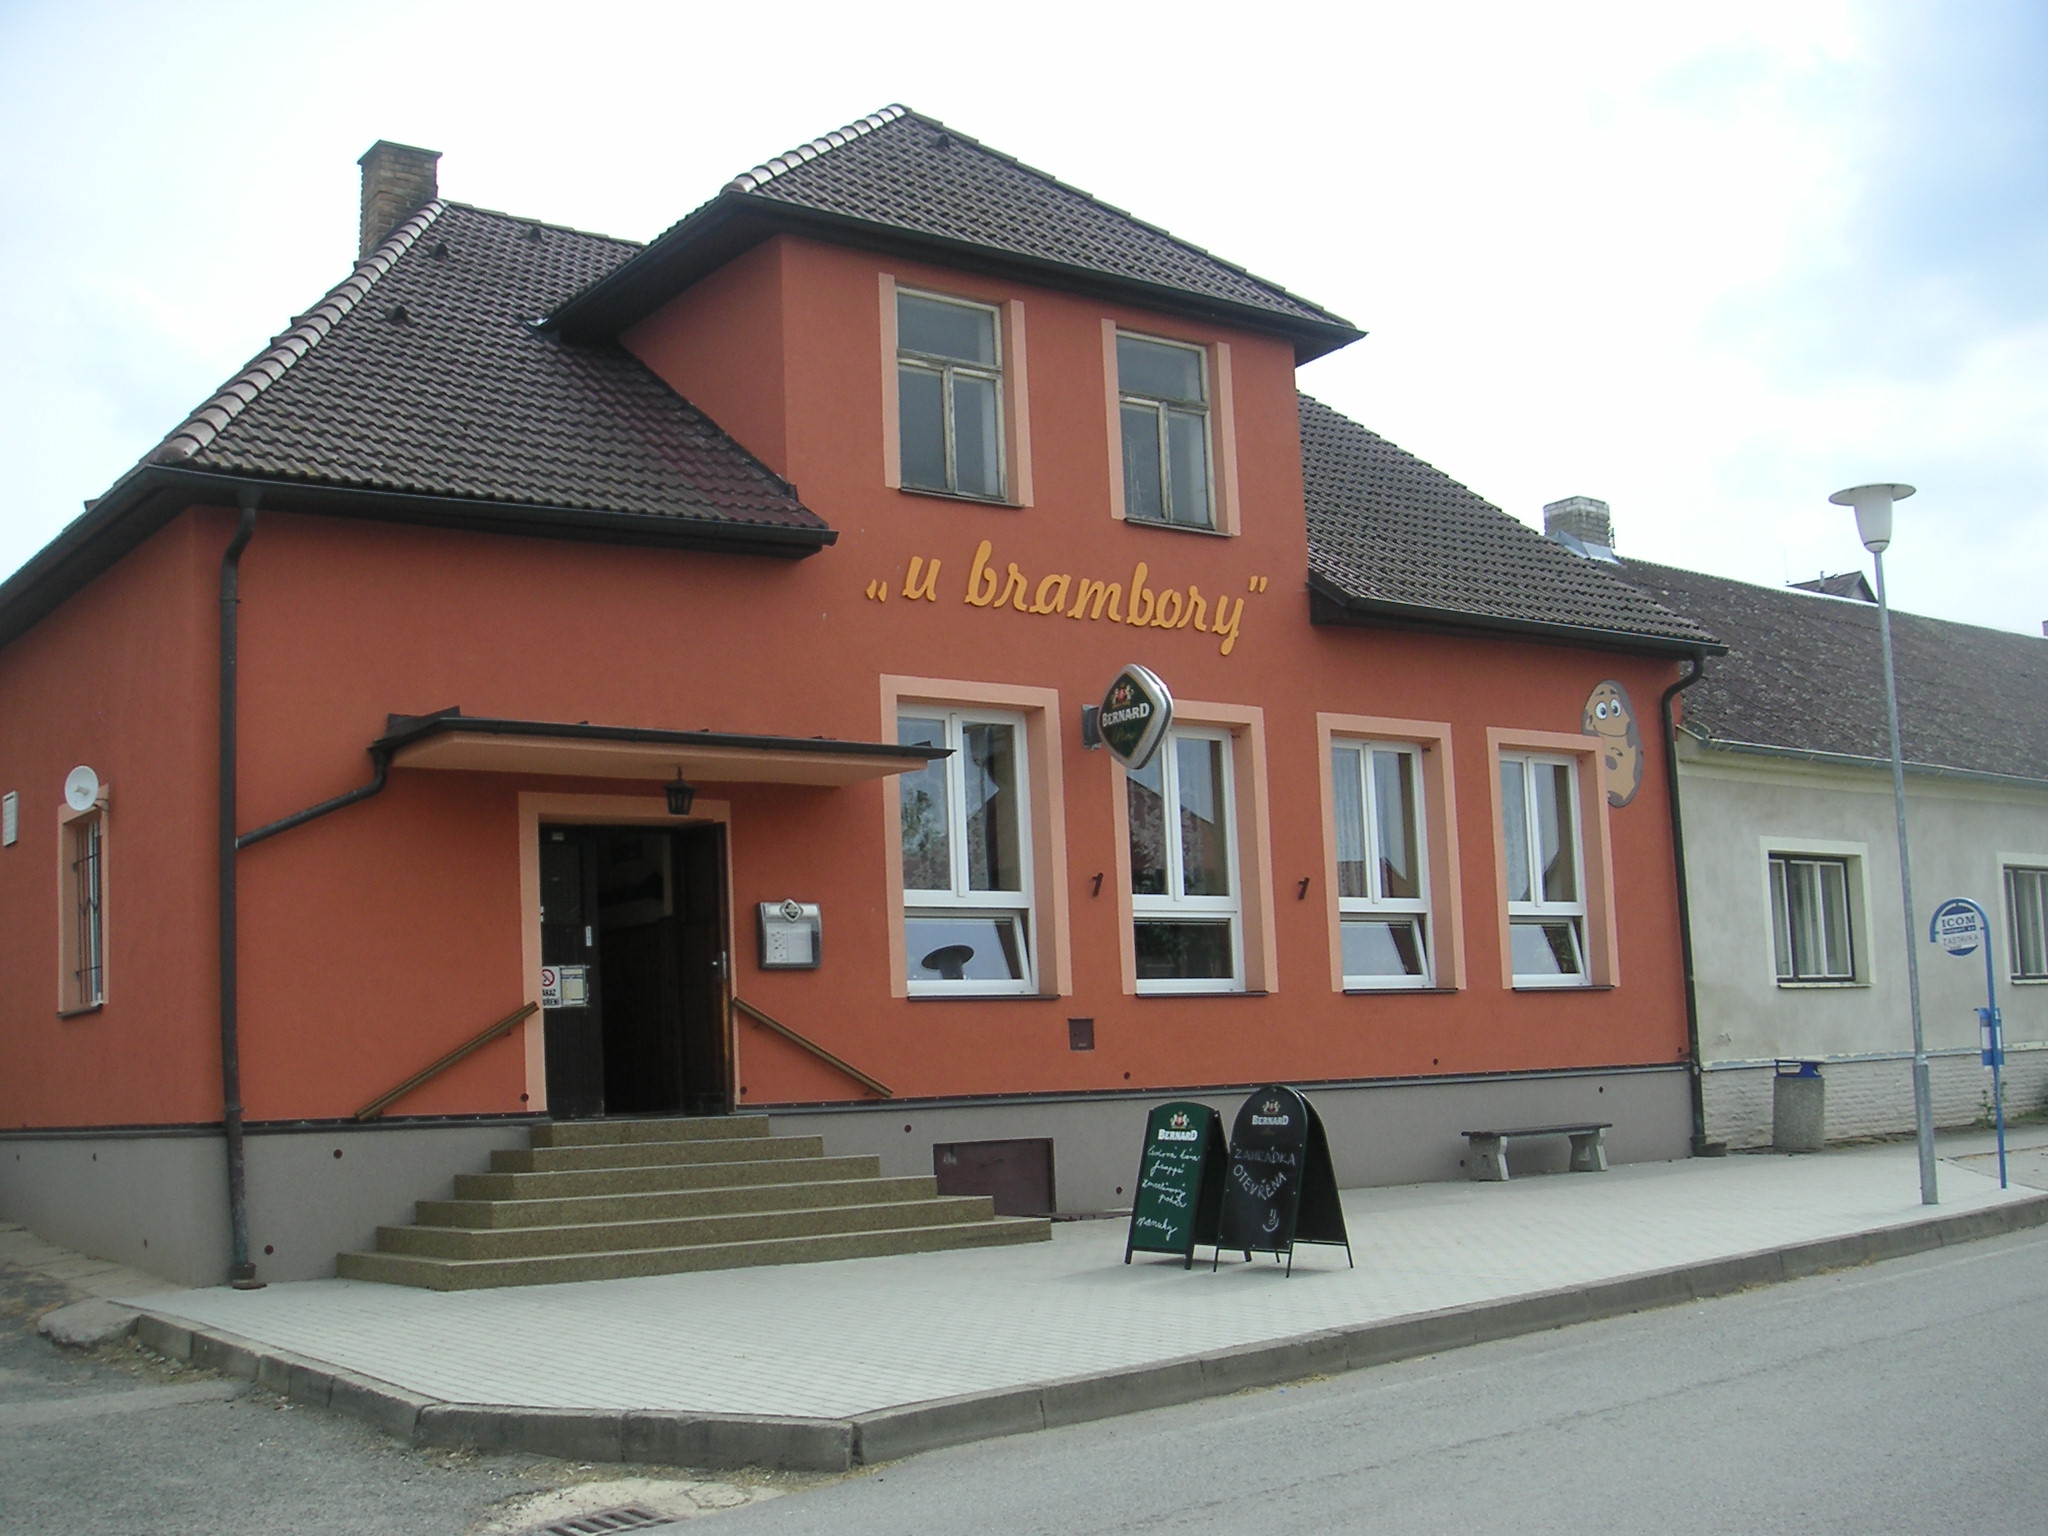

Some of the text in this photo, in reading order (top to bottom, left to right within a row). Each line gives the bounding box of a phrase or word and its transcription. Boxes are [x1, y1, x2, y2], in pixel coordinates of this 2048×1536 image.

[1102, 702, 1150, 727] BERNARD
[1942, 915, 1976, 928] ICOM
[1251, 1115, 1290, 1126] BERNARD
[1157, 1128, 1199, 1142] BERNARD
